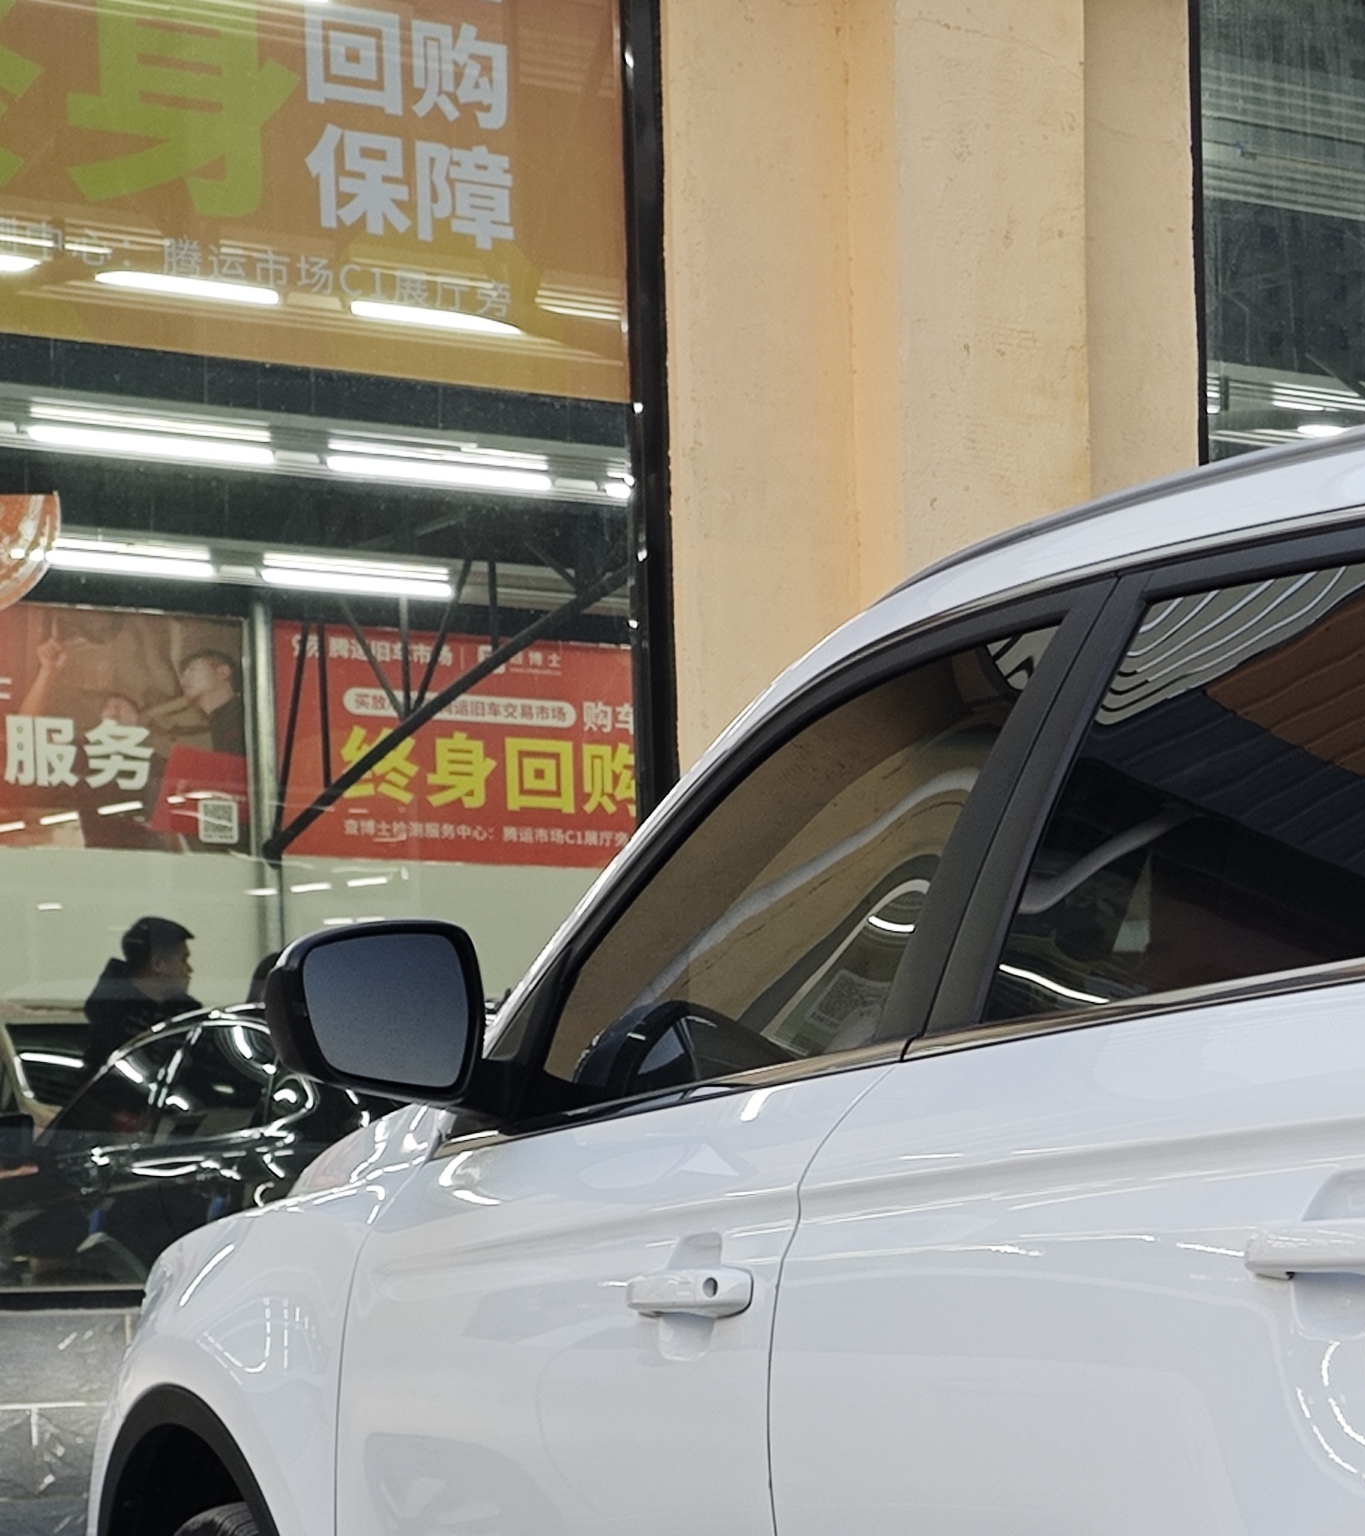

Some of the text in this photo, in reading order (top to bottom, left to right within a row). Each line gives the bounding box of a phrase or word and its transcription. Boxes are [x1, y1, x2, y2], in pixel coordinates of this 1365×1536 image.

[303, 5, 510, 130] 回购
[305, 123, 515, 252] 保障
[4, 714, 155, 791] 服务
[340, 722, 637, 816] 终身回购
